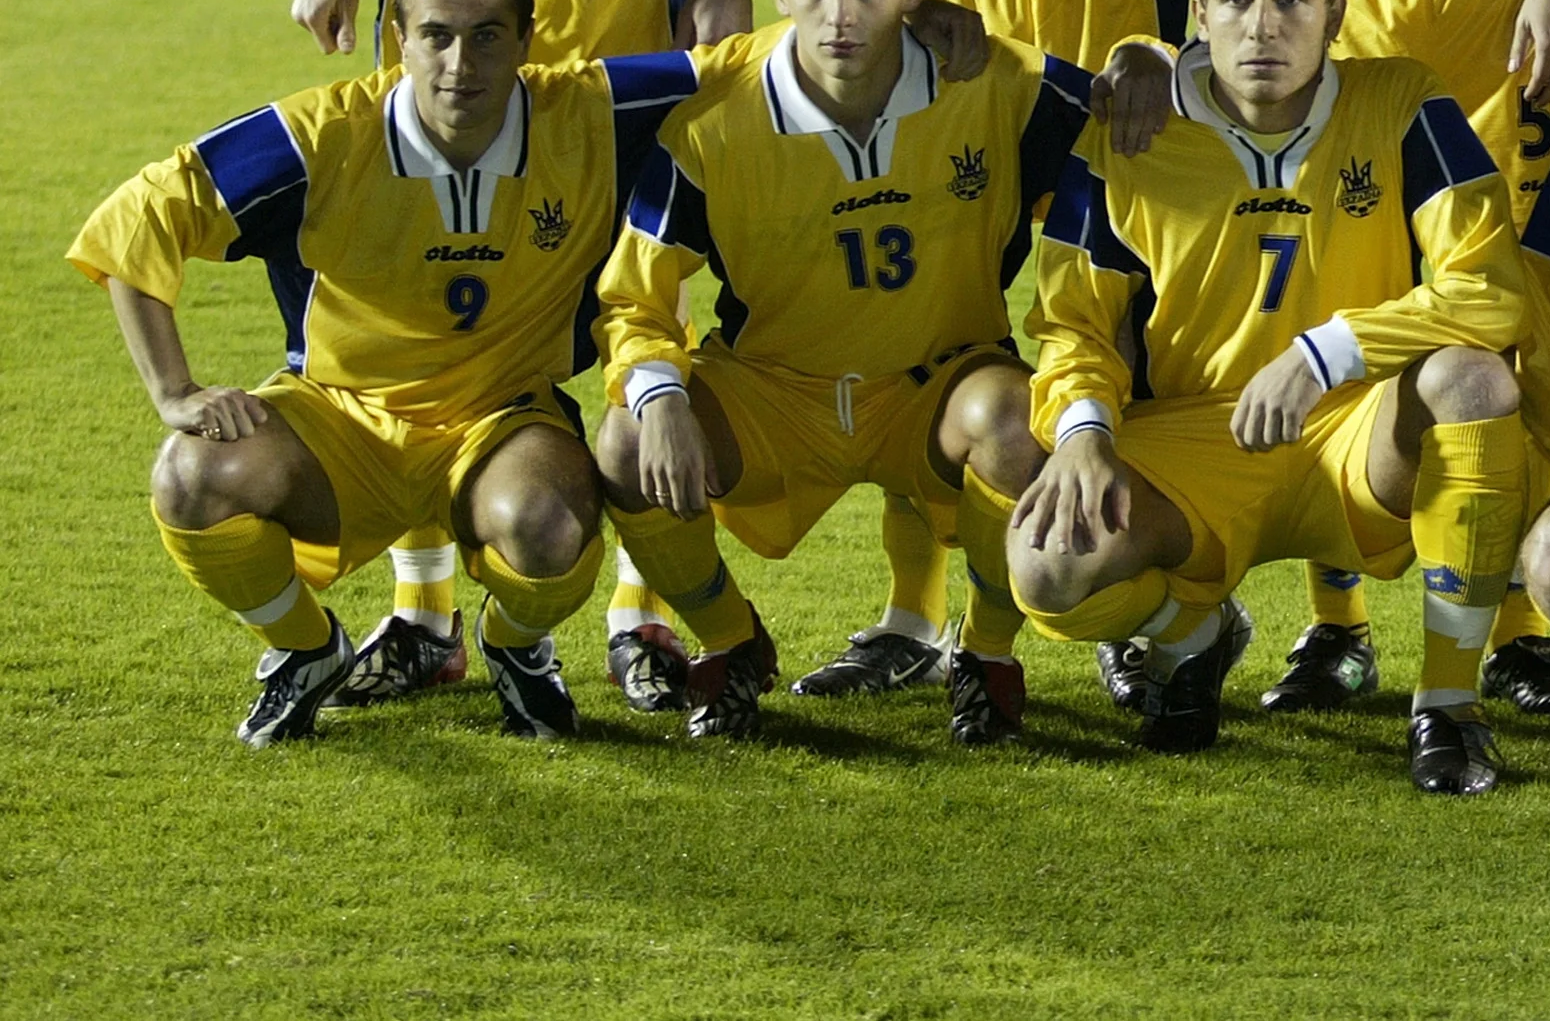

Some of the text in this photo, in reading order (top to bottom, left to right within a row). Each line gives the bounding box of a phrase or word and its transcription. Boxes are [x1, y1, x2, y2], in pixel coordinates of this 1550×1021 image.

[835, 224, 918, 292] 13
[1258, 234, 1302, 313] 7
[444, 273, 489, 333] 9
